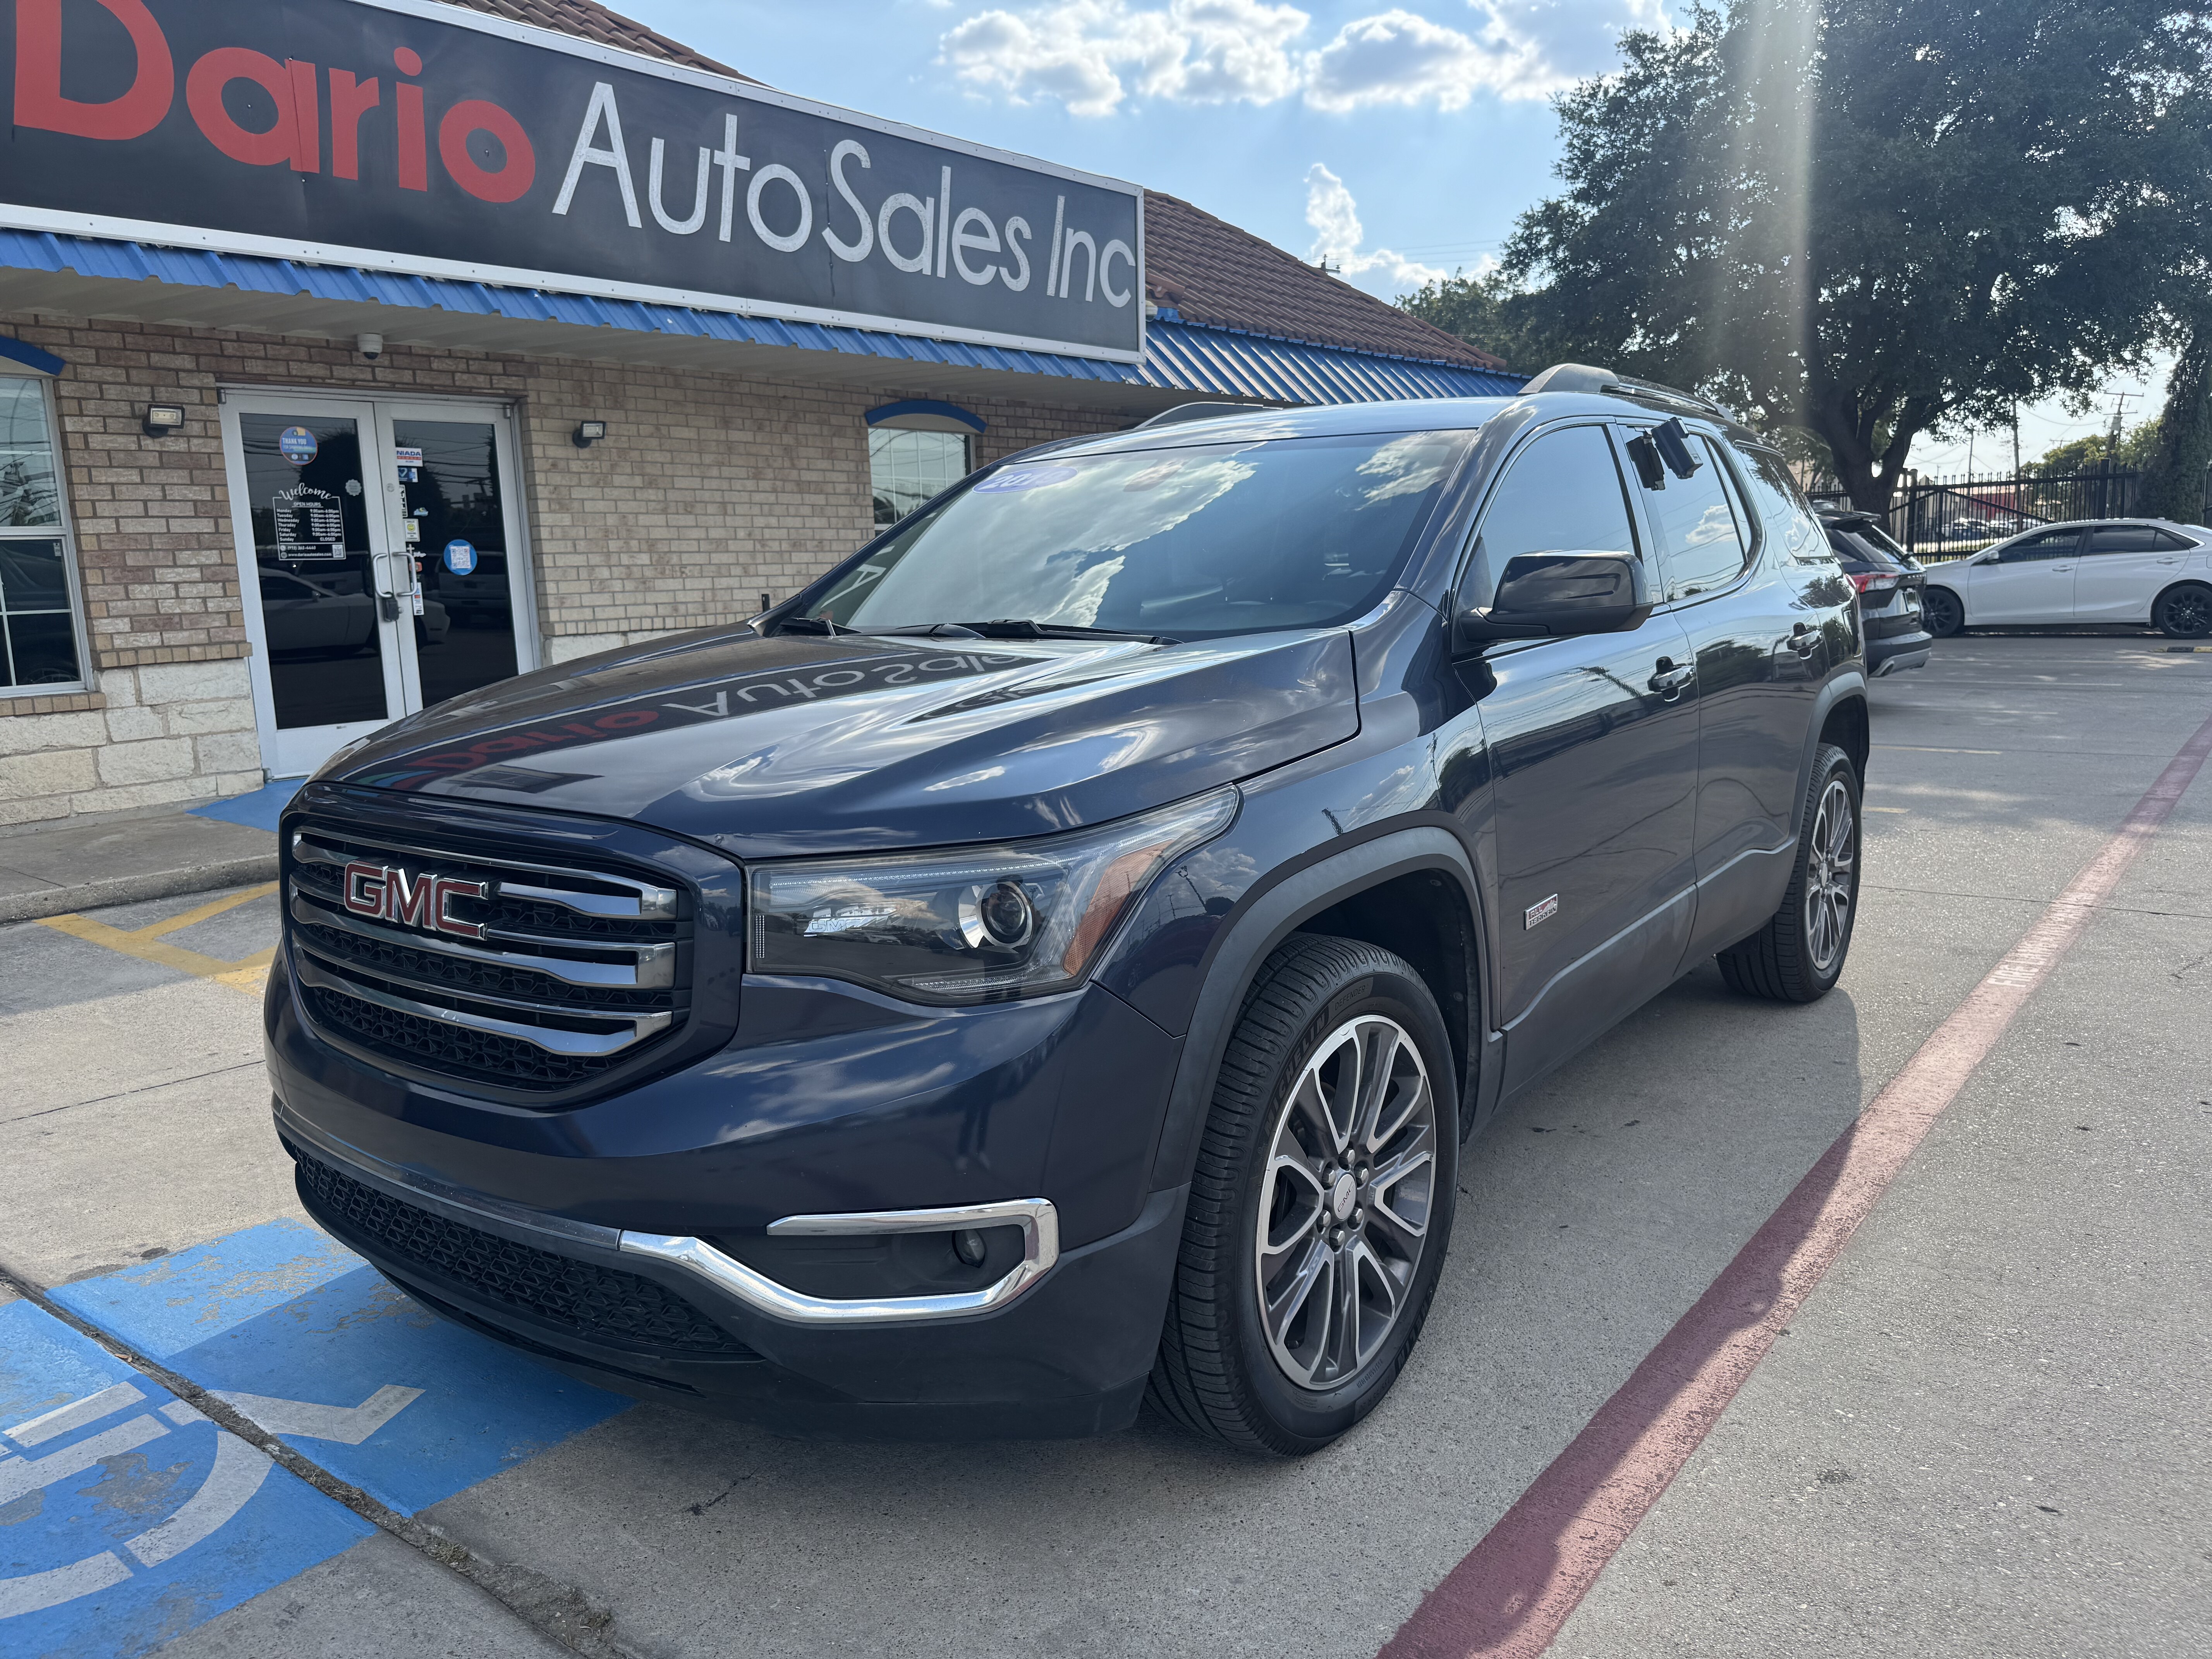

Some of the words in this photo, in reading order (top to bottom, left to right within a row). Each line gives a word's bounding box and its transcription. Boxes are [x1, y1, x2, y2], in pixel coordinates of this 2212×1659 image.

[13, 0, 536, 203] Dario
[1047, 195, 1135, 308] Inc
[279, 483, 332, 501] Welcome
[344, 860, 489, 941] GMC
[1530, 907, 1543, 918] ALL
[1528, 907, 1556, 926] TERRAIN
[1264, 1012, 1326, 1137] MICHELIN
[1335, 985, 1366, 1011] DEFENDER
[1338, 1181, 1354, 1212] GMC
